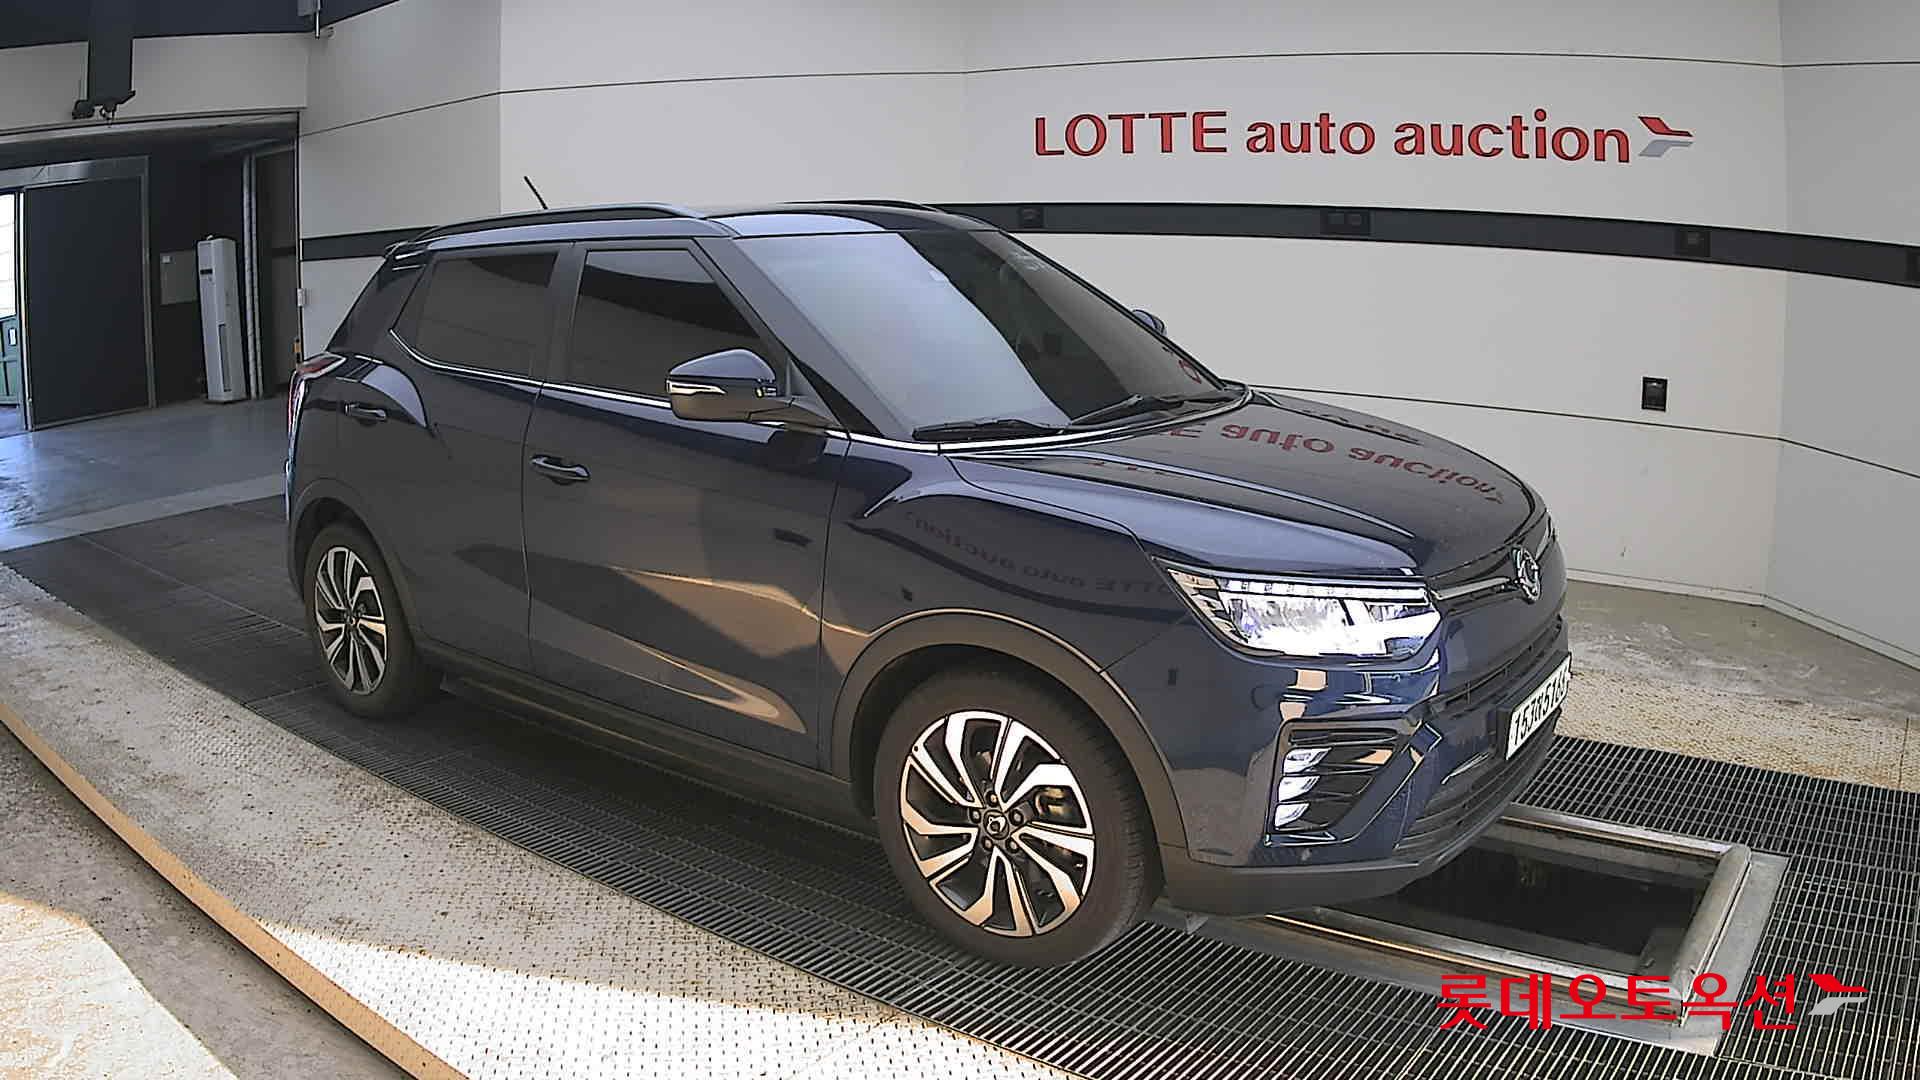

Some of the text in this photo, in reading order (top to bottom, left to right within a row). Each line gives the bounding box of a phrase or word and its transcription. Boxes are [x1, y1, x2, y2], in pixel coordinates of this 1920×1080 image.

[1035, 108, 1630, 164] LOTTE auto auction
